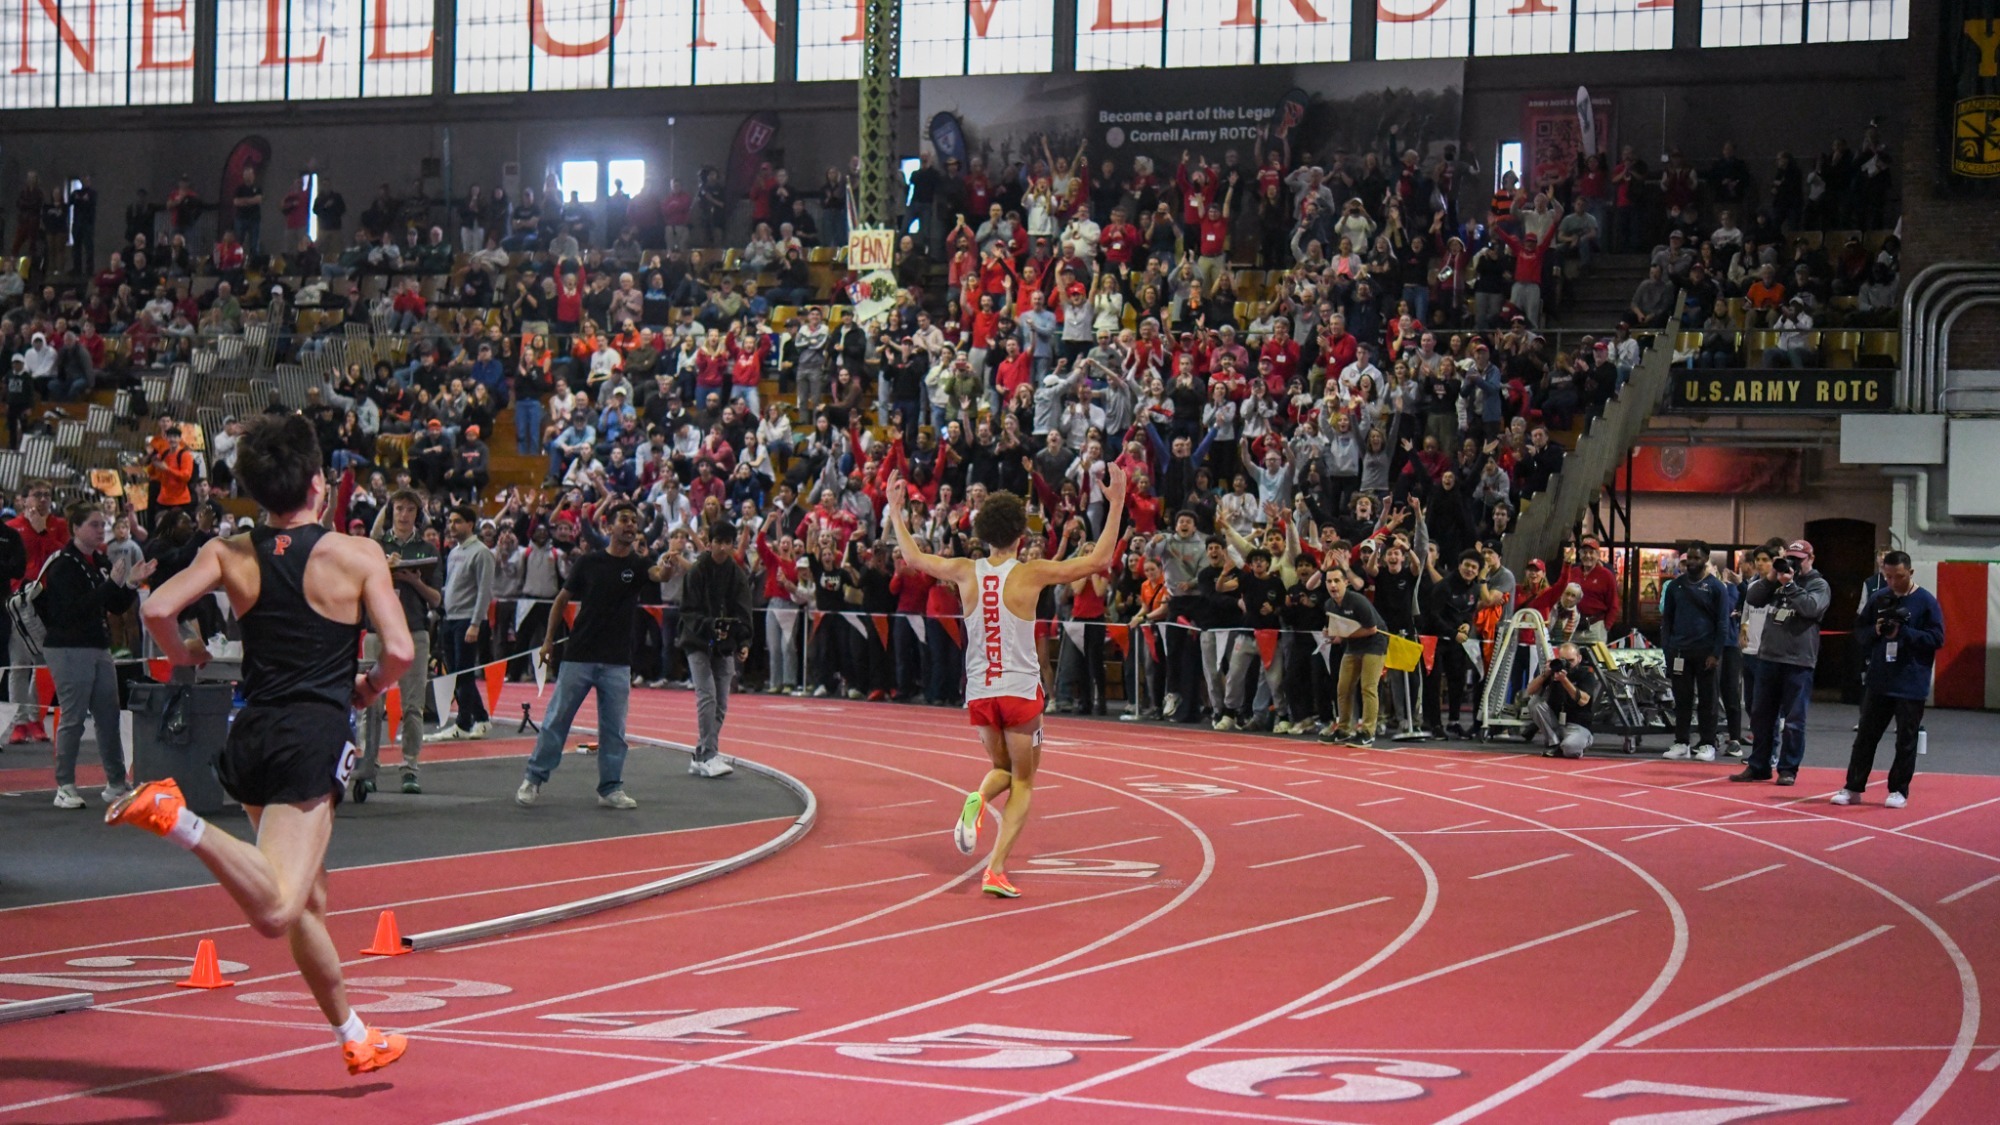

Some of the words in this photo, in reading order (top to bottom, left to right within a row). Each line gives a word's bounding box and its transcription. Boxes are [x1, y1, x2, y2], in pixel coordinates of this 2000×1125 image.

[1099, 110, 1153, 123] Become
[1154, 111, 1163, 121] a
[1165, 108, 1194, 124] part
[1196, 106, 1210, 120] of
[1213, 106, 1235, 120] the
[1238, 106, 1276, 121] Lega
[1130, 128, 1179, 142] Cornell
[1181, 127, 1217, 144] Army
[1219, 126, 1257, 140] ROTC
[850, 235, 892, 266] PENN
[1816, 380, 1878, 402] ROTC
[273, 534, 292, 556] P
[1008, 858, 1161, 878] 2
[235, 976, 513, 1013] 3
[536, 1006, 800, 1039] 4
[835, 1023, 1133, 1068] 5
[1186, 1056, 1462, 1102] 6
[1582, 1080, 1850, 1125] 7
